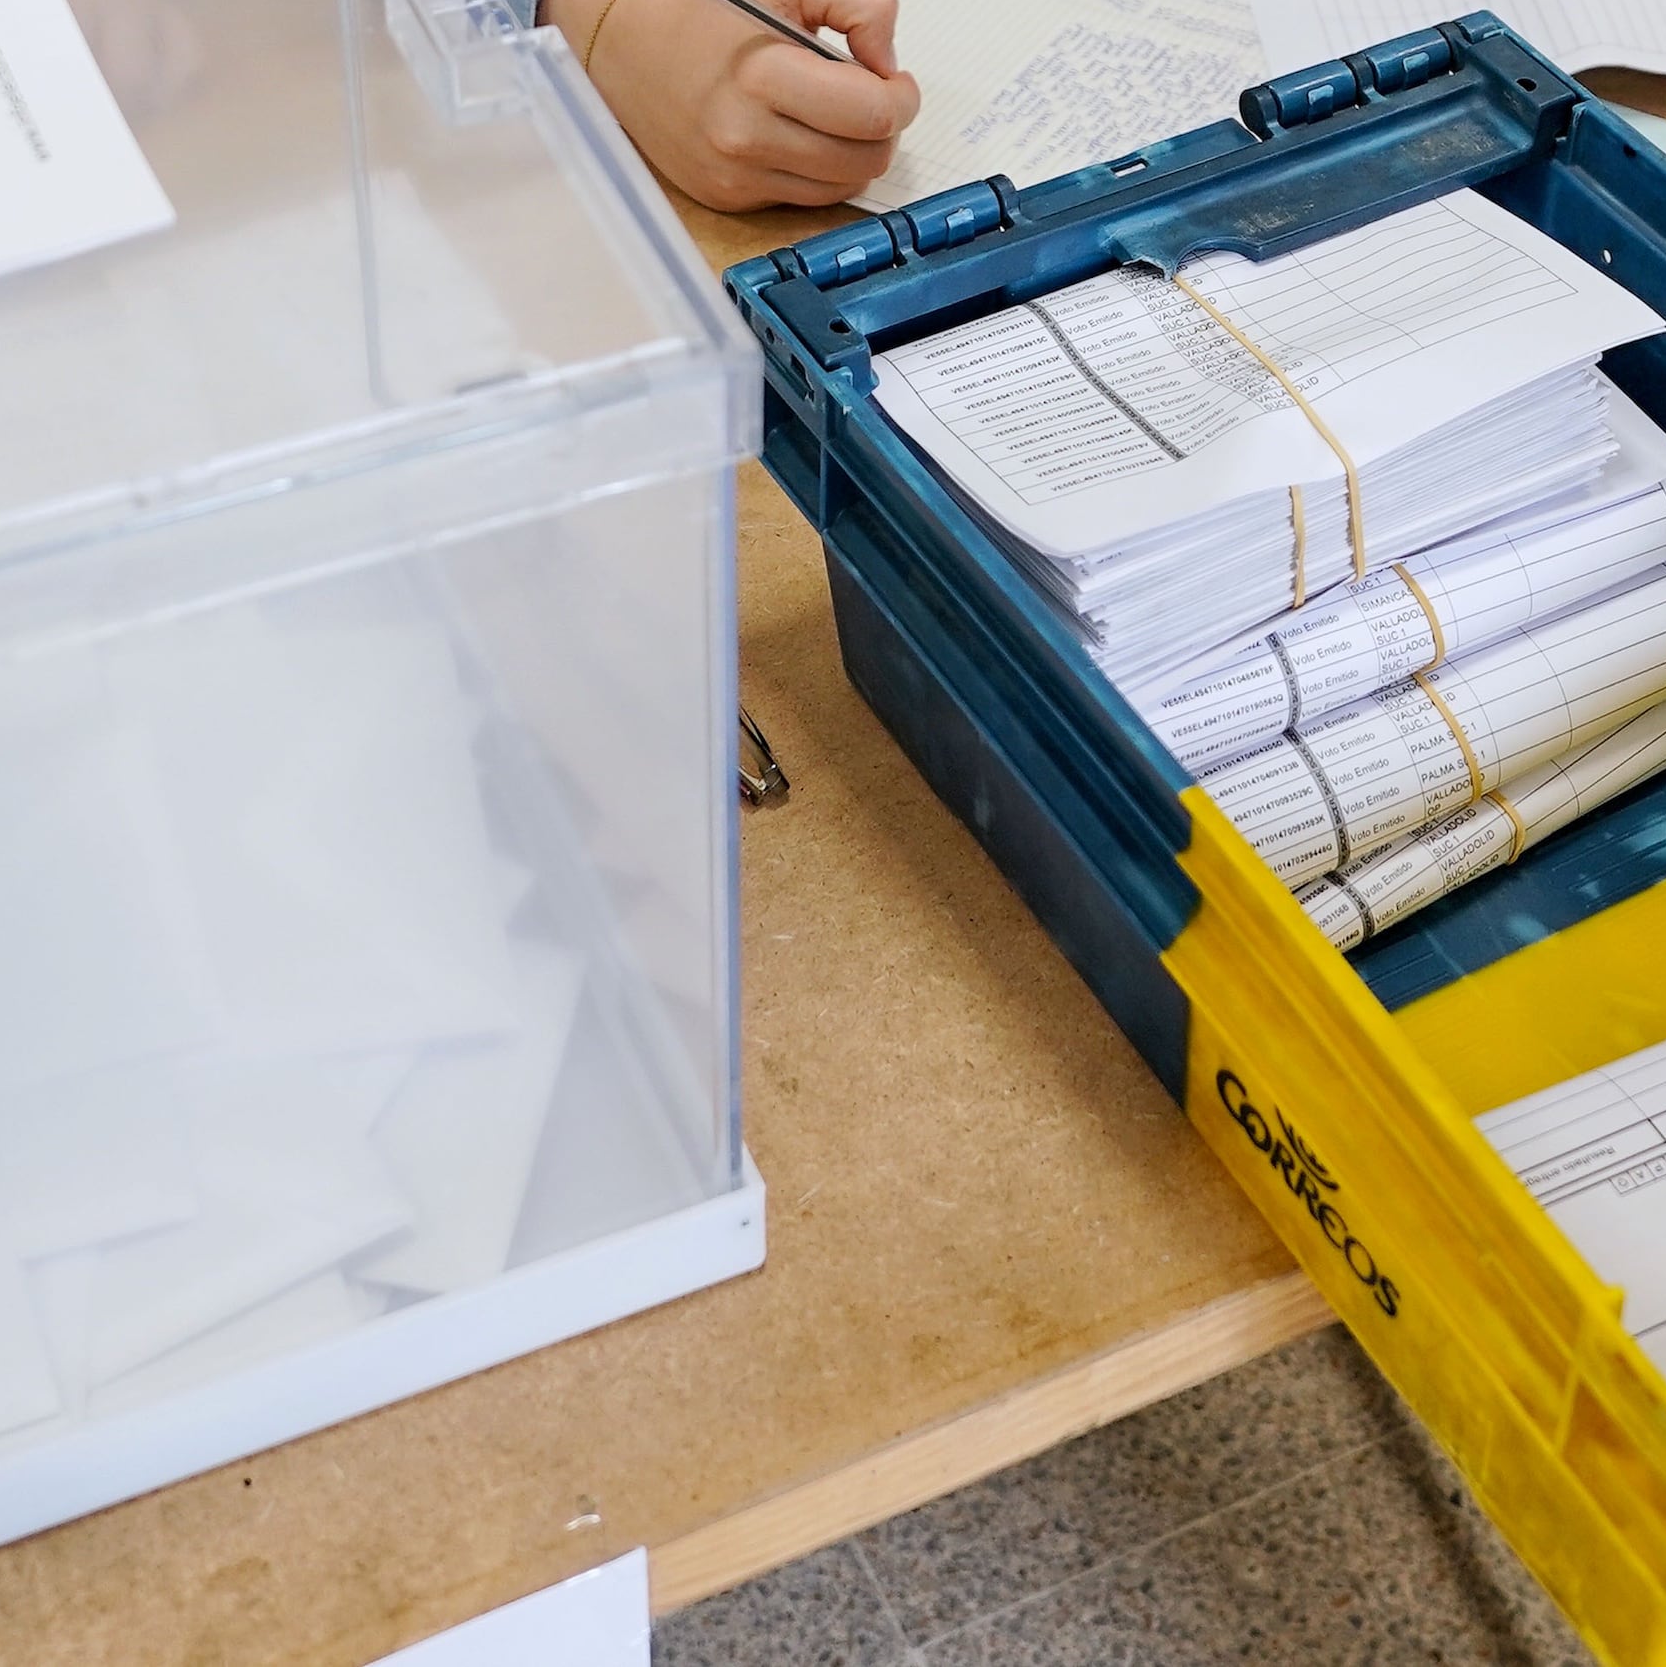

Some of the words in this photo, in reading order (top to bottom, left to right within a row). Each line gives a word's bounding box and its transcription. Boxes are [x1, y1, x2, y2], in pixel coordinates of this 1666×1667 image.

[1051, 305, 1074, 317] Voto
[1075, 293, 1109, 309] Emitido
[1147, 298, 1170, 311] SUC
[1065, 322, 1087, 335] Voto
[1089, 310, 1124, 327] Emitido
[1161, 318, 1184, 331] SUC
[1079, 342, 1101, 354] Voto
[1102, 329, 1137, 347] Emitido
[1175, 337, 1199, 350] SUC
[1092, 359, 1115, 372] Voto
[1116, 347, 1151, 365] Emitido
[1255, 375, 1319, 405] VALLAOLID
[1263, 398, 1286, 411] SUC
[1350, 579, 1374, 593] SUC
[1375, 577, 1381, 585] 1
[1281, 622, 1303, 640] Voto
[1305, 614, 1339, 633] Emitido
[1362, 588, 1413, 613] SIMANCAS
[1293, 648, 1316, 666] Voto
[1317, 640, 1352, 659] Emitido
[1371, 608, 1425, 632] VALLADOL
[1376, 634, 1396, 646] SUC
[1400, 628, 1406, 637] 1
[1302, 678, 1324, 695] Voto
[1326, 669, 1359, 686] Emitido
[1380, 637, 1432, 660] VALLADOL
[1382, 660, 1402, 674] SUC
[1405, 657, 1411, 665] 1
[1302, 723, 1324, 737] Voto
[1325, 710, 1360, 728] Emitido
[1376, 673, 1440, 703] VALLADOID
[1384, 700, 1405, 711] SUC
[1408, 695, 1415, 703] 1
[1317, 744, 1339, 759] Voto
[1341, 732, 1376, 750] Emitido
[1393, 692, 1456, 722] VALLADID
[1401, 721, 1421, 734] SUC
[1424, 716, 1430, 726] 1
[1331, 771, 1353, 786] Voto
[1354, 758, 1389, 777] Emitido
[1411, 736, 1446, 754] PALMA
[1470, 723, 1477, 732] 1
[1343, 798, 1365, 815] Voto
[1366, 786, 1400, 805] Emitido
[1421, 763, 1456, 783] PALMA
[1481, 752, 1486, 761] 1
[1351, 829, 1371, 843] Voto
[1372, 815, 1405, 833] Emitido
[1423, 809, 1477, 847] VALLADOLID
[1343, 862, 1365, 879] Voto
[1363, 842, 1392, 867] Emitido
[1442, 830, 1495, 870] VALLADOLID
[1362, 879, 1383, 899] Voto
[1383, 860, 1412, 886] Emitido
[1433, 842, 1452, 858] SUC
[1454, 836, 1460, 846] 1
[1376, 908, 1397, 924] Voto
[1396, 887, 1426, 913] Emitido
[1446, 868, 1464, 884] SUC
[1465, 861, 1470, 872] 1
[1562, 1143, 1615, 1173] Resultado
[1217, 1069, 1400, 1317] CORREOS
